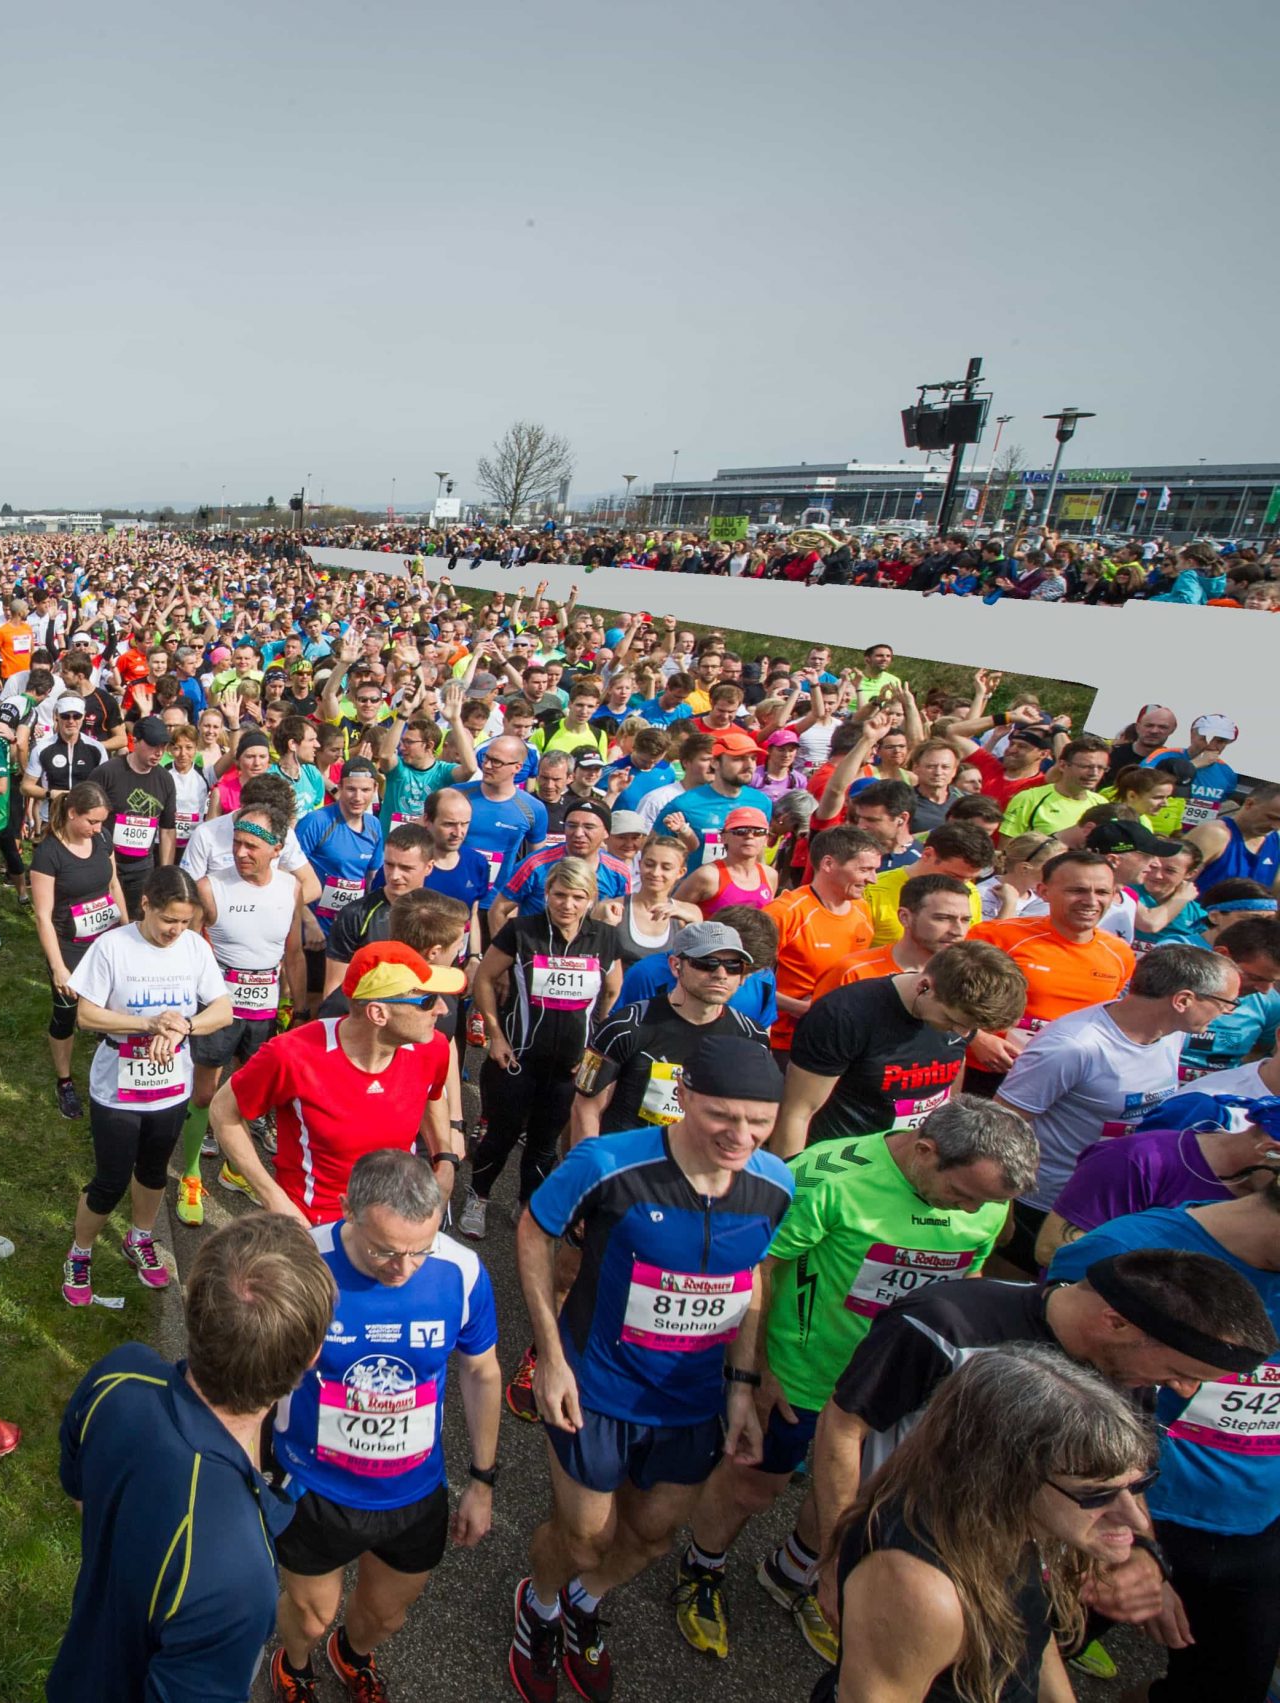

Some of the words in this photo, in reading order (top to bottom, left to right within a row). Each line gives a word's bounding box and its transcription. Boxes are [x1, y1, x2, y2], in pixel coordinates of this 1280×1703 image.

[1069, 470, 1132, 483] Freiburg
[1185, 806, 1209, 819] 898
[123, 827, 148, 839] 4806
[229, 904, 256, 912] PULZ
[82, 908, 115, 927] 11052
[547, 972, 584, 988] 4611
[234, 986, 269, 999] 4963
[548, 988, 582, 997] Carmen
[134, 1077, 169, 1087] Barbara
[912, 1214, 951, 1227] hummel
[912, 1252, 958, 1267] Rothaus
[682, 1275, 732, 1291] Rothaus
[653, 1294, 726, 1317] 8198
[653, 1318, 717, 1332] Stephan
[343, 1414, 409, 1437] 7021
[349, 1437, 406, 1451] Norbert
